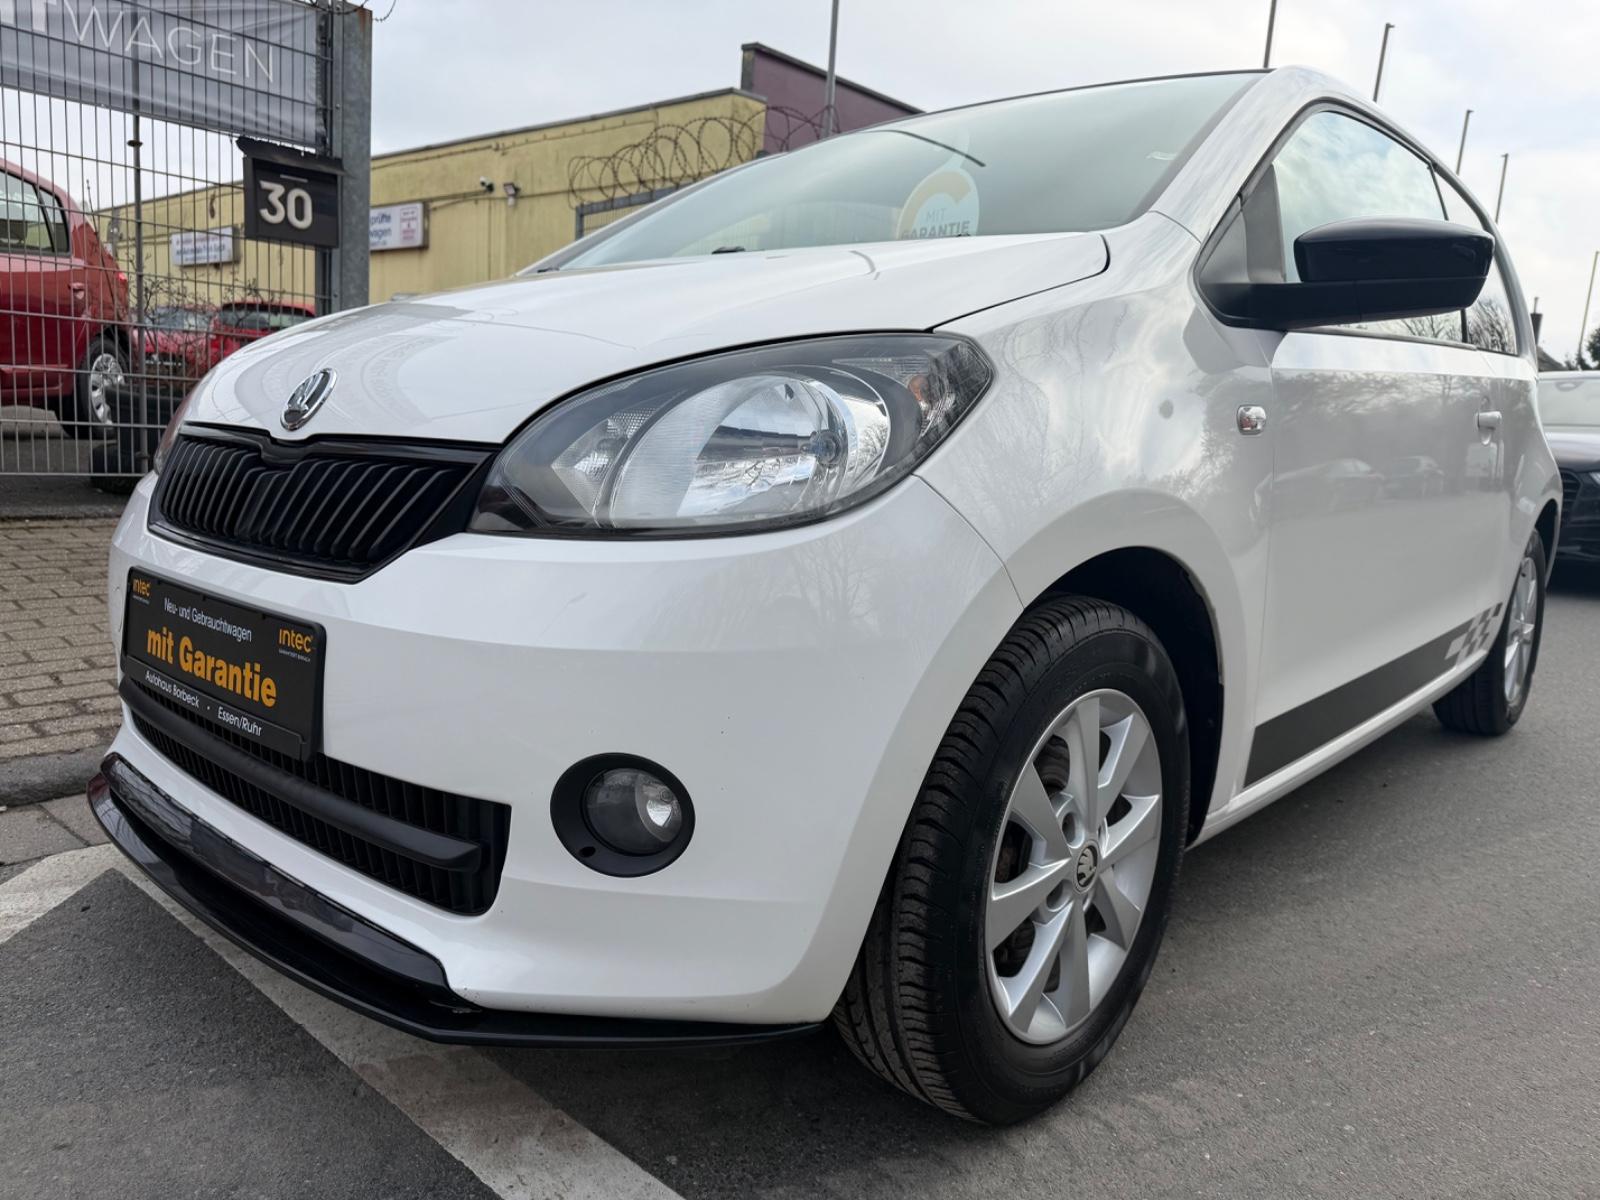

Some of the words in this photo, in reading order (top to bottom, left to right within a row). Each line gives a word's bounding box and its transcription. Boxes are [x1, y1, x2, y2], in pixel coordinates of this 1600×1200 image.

[259, 180, 313, 230] 30
[164, 597, 178, 615] Neu-
[179, 605, 191, 620] und
[191, 607, 252, 643] Gebrauchtwagen
[147, 626, 174, 665] mit
[179, 635, 277, 708] Garantie
[145, 670, 172, 694] Autohaus
[172, 680, 199, 709] Borbeck
[217, 706, 262, 737] Essen/Ruhr
